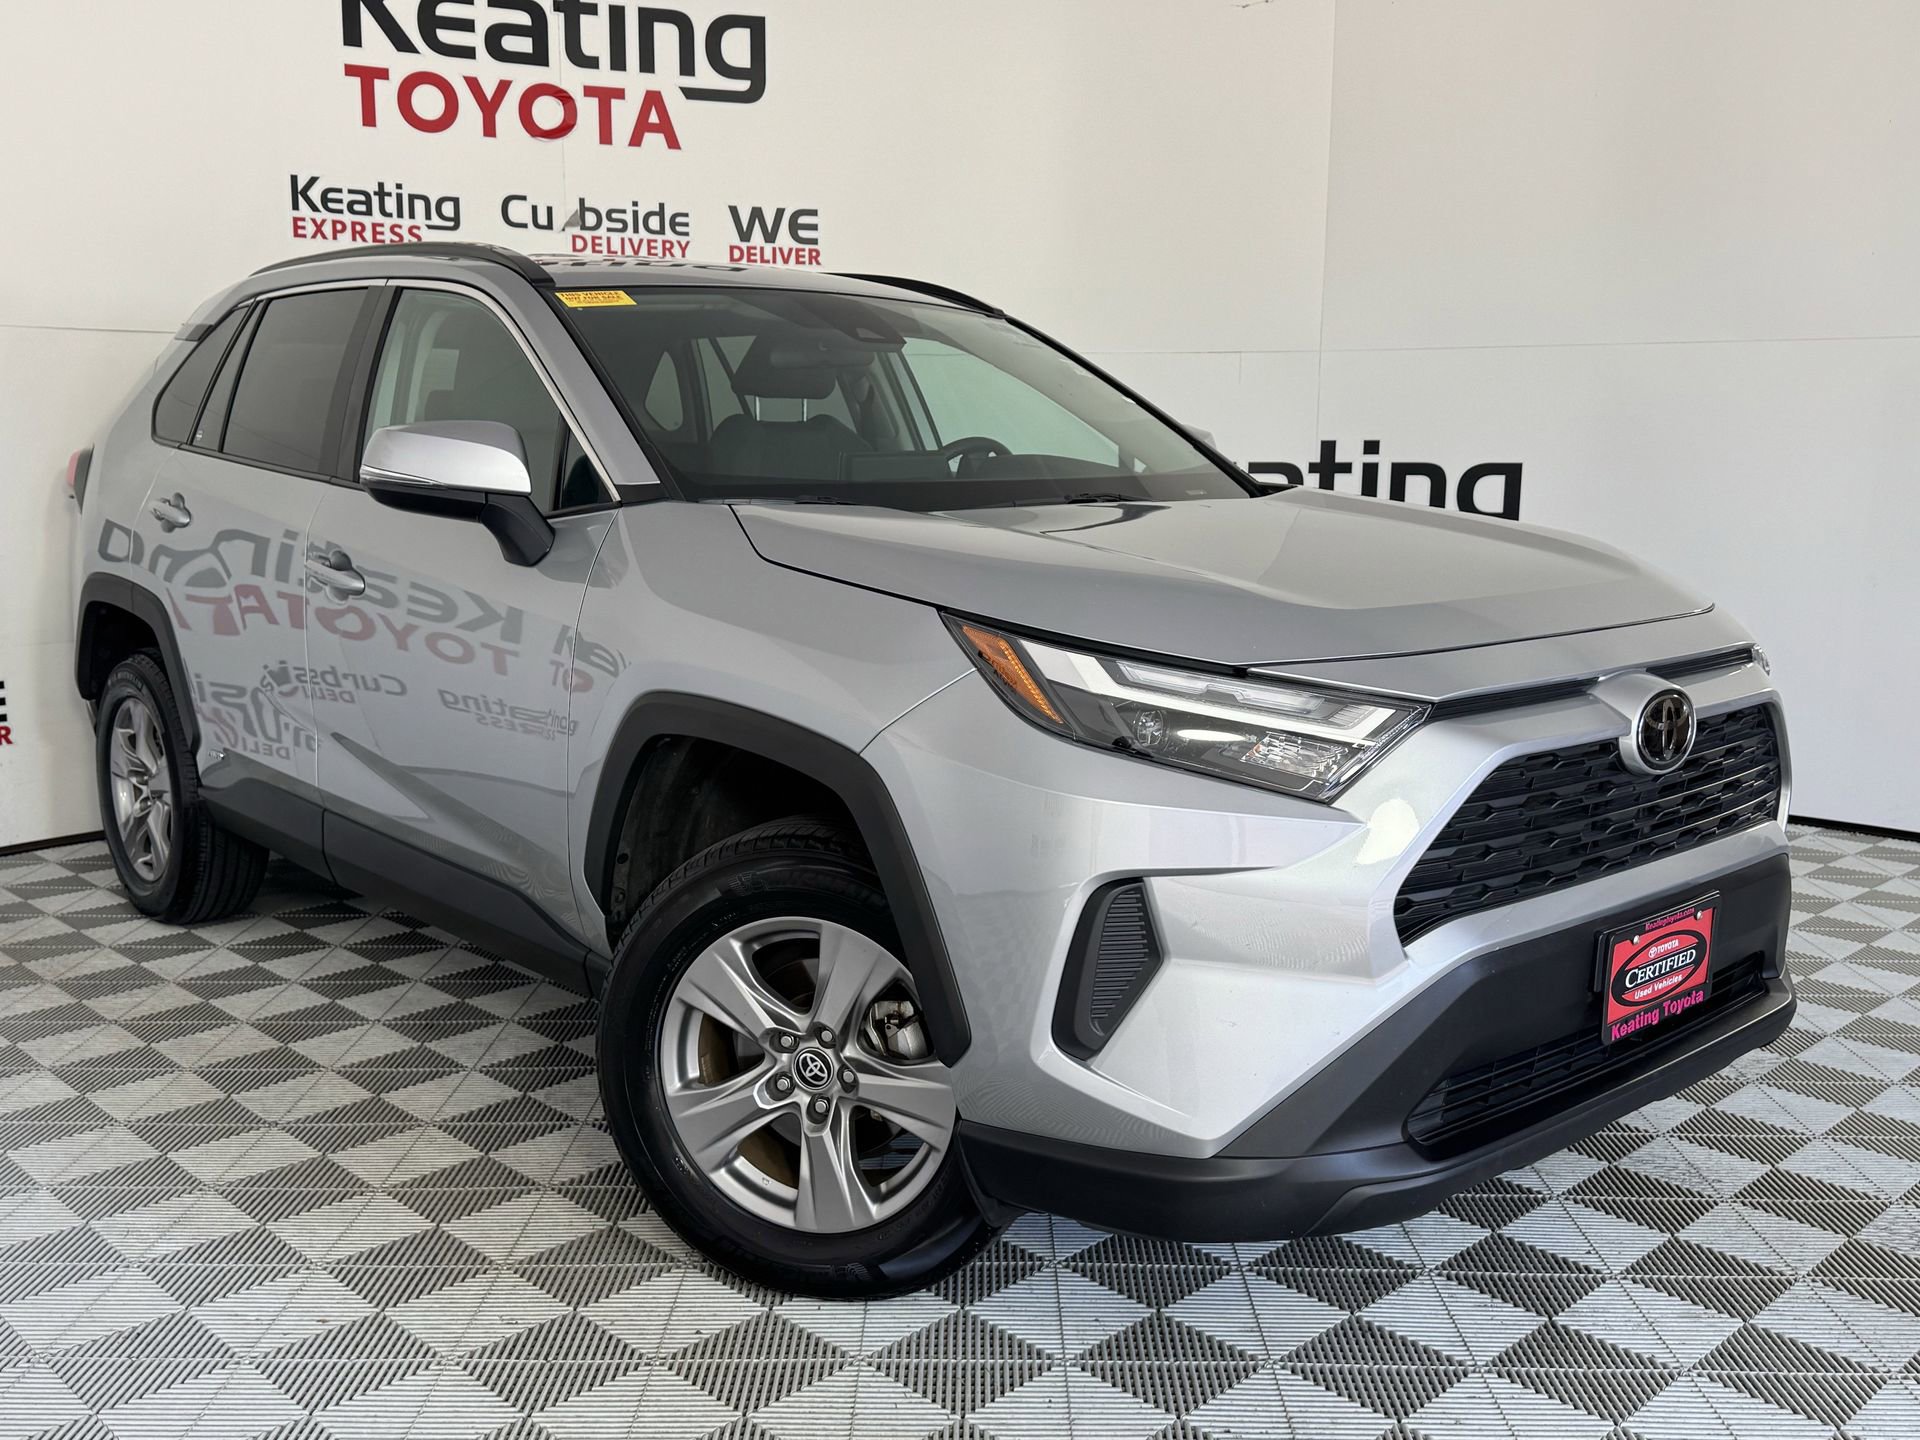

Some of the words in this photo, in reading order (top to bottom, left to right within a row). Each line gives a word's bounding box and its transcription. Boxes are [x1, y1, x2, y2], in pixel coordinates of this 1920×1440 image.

[344, 63, 682, 150] TOYOTA
[290, 174, 461, 231] Keating
[501, 194, 690, 237] Cubside
[292, 216, 423, 244] EXPRESS
[728, 205, 819, 245] WE
[571, 234, 691, 258] DELIVERY
[729, 245, 822, 265] DELIVER
[1657, 939, 1679, 953] TOYOTA
[1625, 949, 1697, 988] CERTIFIED
[1634, 986, 1653, 999] Used
[1611, 1008, 1660, 1041] Keating
[1663, 990, 1704, 1017] Toyota
